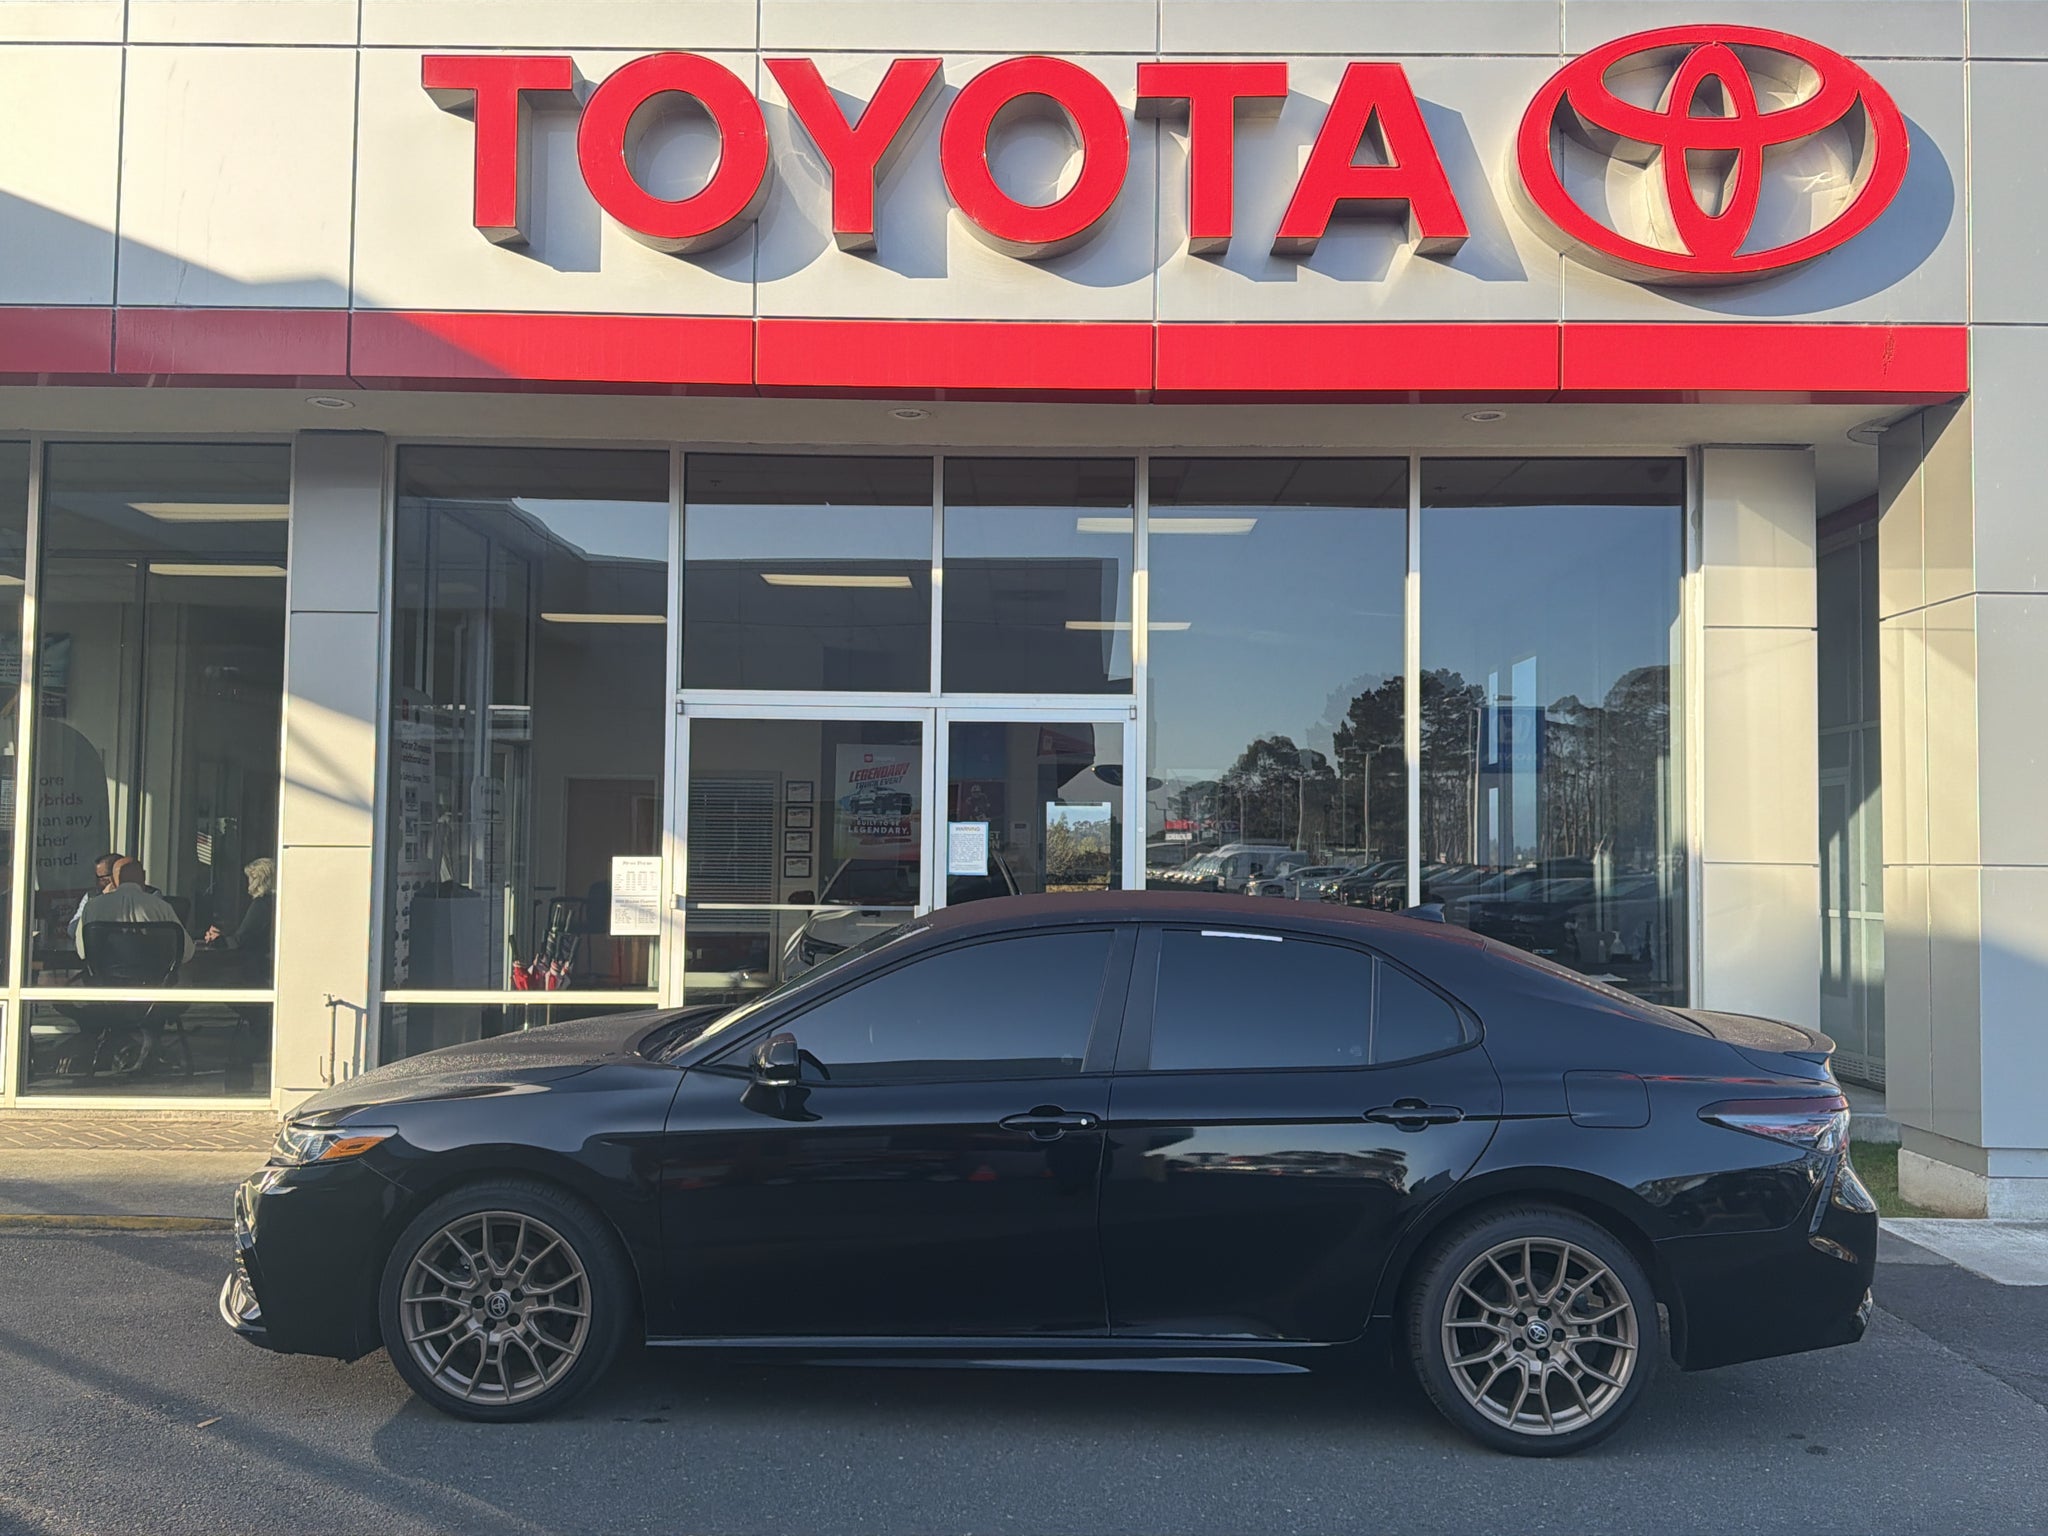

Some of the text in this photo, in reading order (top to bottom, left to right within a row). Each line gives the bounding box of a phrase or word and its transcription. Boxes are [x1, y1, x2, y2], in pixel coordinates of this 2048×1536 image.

[421, 51, 1471, 258] TOYOTA
[849, 762, 910, 783] LEGENDARY
[40, 776, 64, 786] ore
[38, 793, 83, 808] brids
[38, 815, 93, 828] an any
[848, 825, 910, 835] LEGENDARY.
[37, 834, 69, 847] ther
[37, 852, 78, 867] rand!
